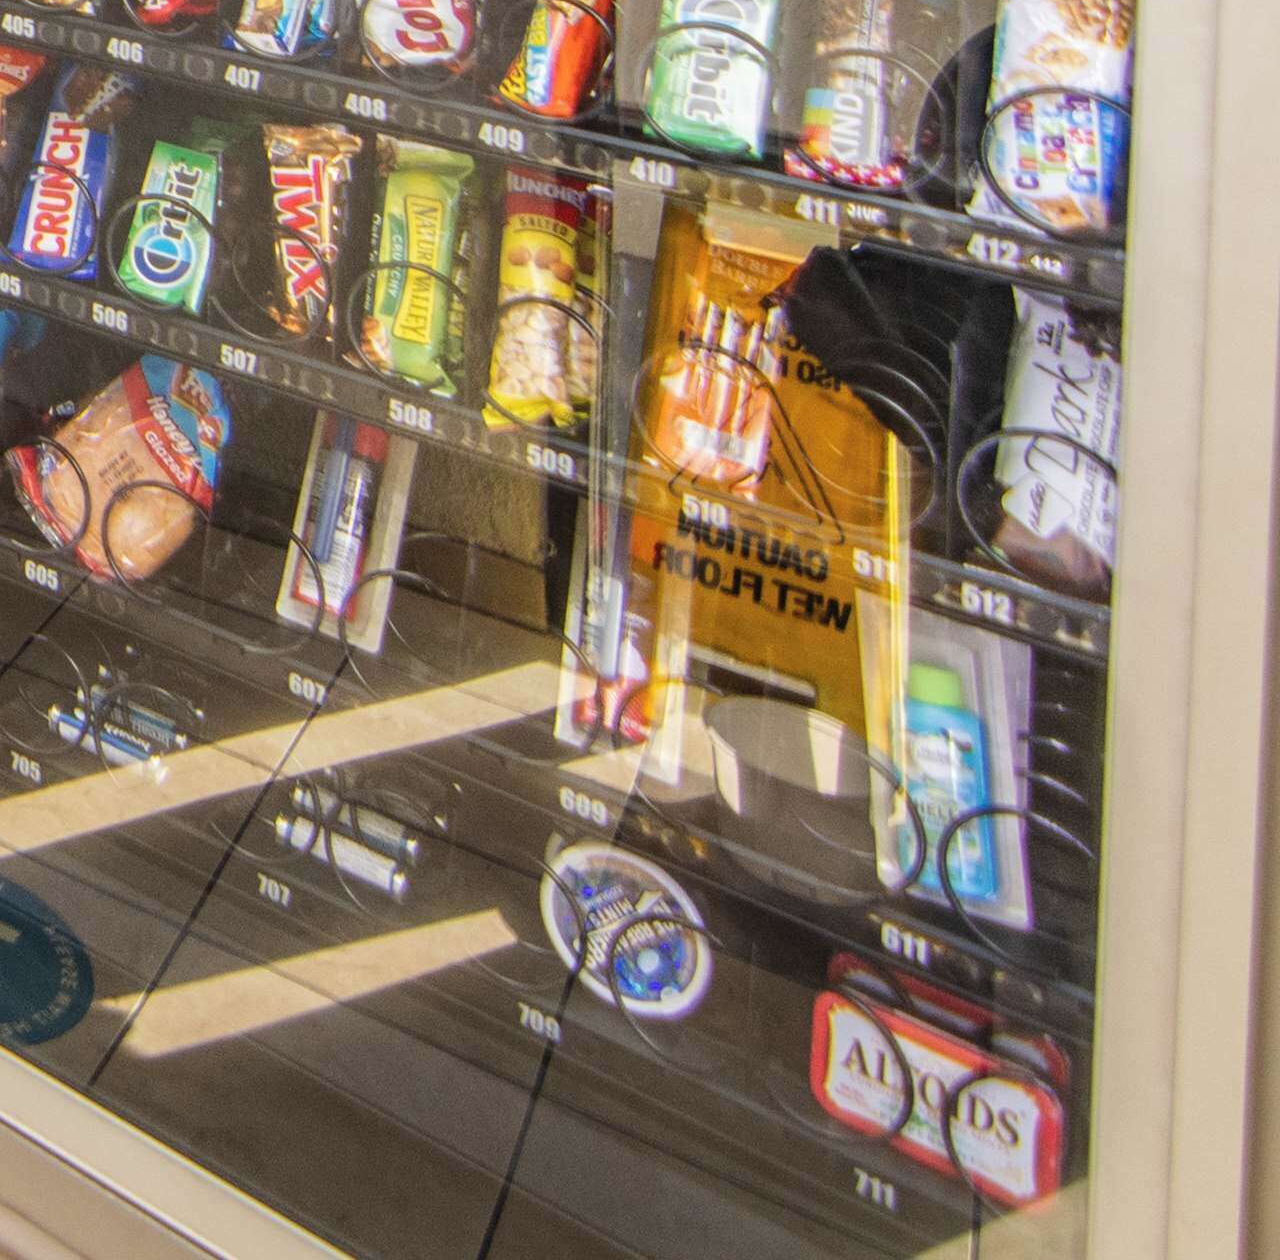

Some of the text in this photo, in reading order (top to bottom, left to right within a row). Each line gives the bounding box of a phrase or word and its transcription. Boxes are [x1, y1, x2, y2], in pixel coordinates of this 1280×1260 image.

[1, 14, 35, 38] 405
[107, 38, 144, 63] 406
[224, 65, 261, 92] 407
[344, 92, 389, 121] 408
[478, 122, 526, 153] 409
[30, 117, 86, 258] CRUNCH
[629, 156, 676, 187] 410
[519, 216, 569, 236] SALTED
[793, 196, 839, 224] 411
[270, 154, 328, 303] TWIX
[966, 234, 1022, 269] 412
[92, 302, 128, 332] 506
[401, 272, 432, 338] VALLEY
[220, 344, 258, 374] 507
[389, 401, 433, 431] 508
[145, 431, 186, 483] Glazed
[526, 445, 577, 478] 509
[682, 495, 729, 528] 510
[25, 560, 59, 591] 605
[852, 549, 898, 583] 511
[960, 585, 1017, 622] 512
[289, 671, 326, 705] 607
[11, 751, 40, 779] 705
[559, 786, 609, 827] 609
[257, 872, 291, 908] 707
[881, 923, 929, 966] 611
[517, 1002, 561, 1044] 709
[854, 1168, 896, 1210] 711
